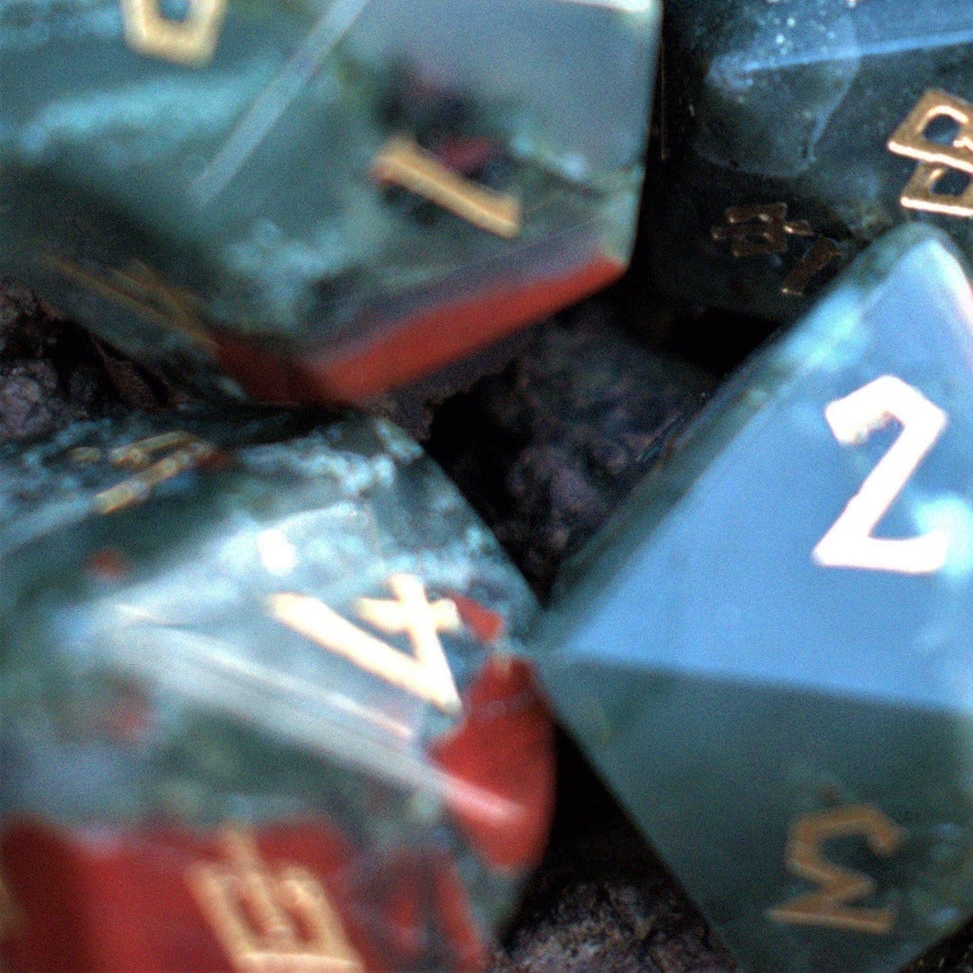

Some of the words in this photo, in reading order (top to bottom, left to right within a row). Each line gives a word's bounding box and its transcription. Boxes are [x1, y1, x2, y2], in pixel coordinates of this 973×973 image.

[812, 373, 950, 575] 2
[264, 571, 463, 716] 4
[766, 803, 902, 936] 3
